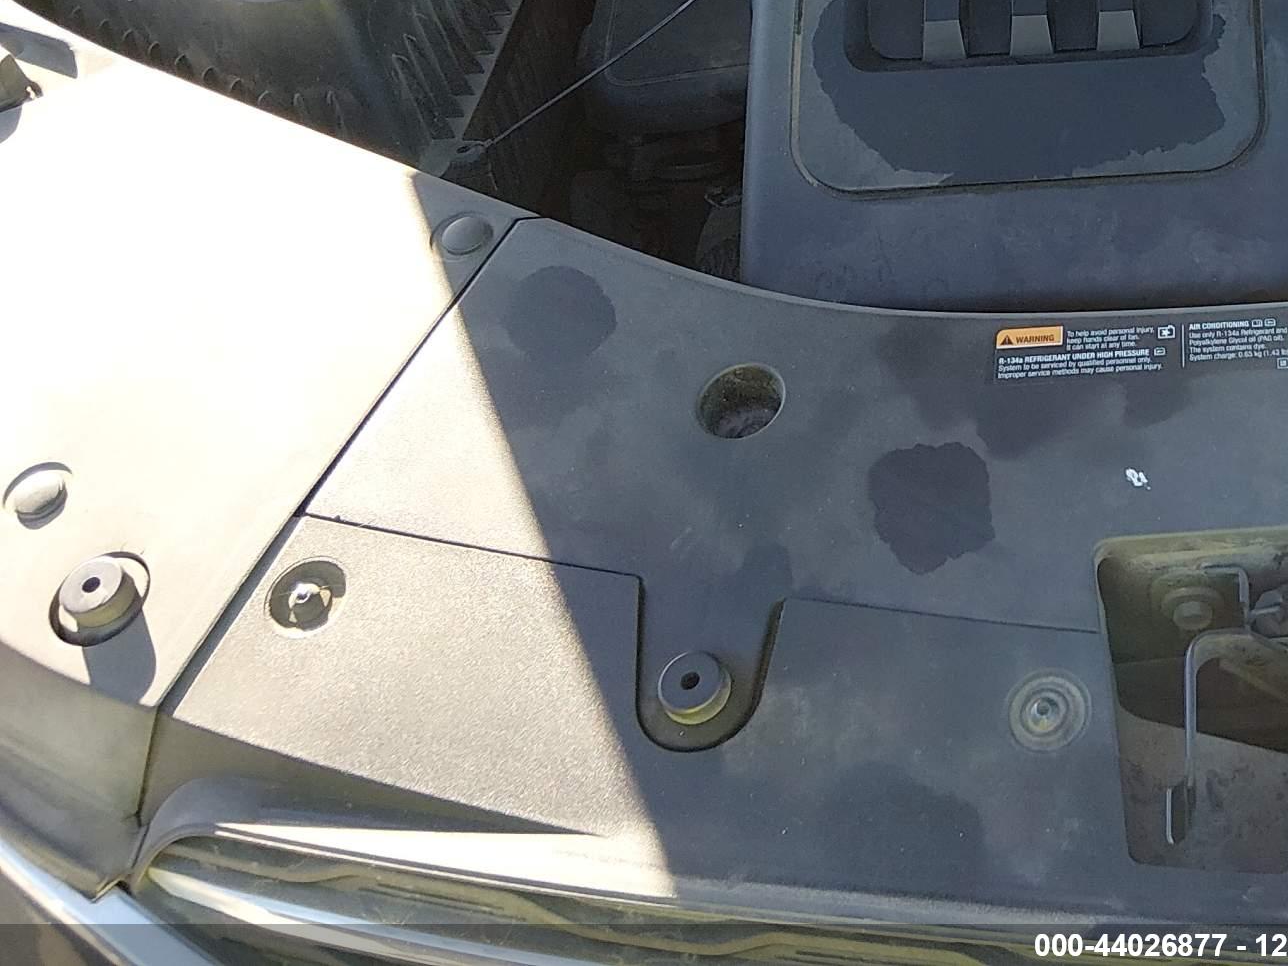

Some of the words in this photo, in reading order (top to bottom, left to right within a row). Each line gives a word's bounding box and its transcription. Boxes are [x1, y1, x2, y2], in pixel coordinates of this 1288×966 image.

[1202, 320, 1250, 330] CONDITIONING
[1108, 327, 1135, 336] personal
[1202, 331, 1215, 339] only
[1241, 328, 1275, 336] Refrigerant
[1016, 335, 1054, 344] WARNING
[1189, 337, 1228, 346] Polyalkylene
[1228, 336, 1248, 344] Glycol
[1202, 345, 1225, 353] system
[1226, 343, 1253, 351] contains
[998, 357, 1024, 365] R-134a
[1024, 354, 1071, 363] REFRIGERANT
[1072, 352, 1095, 360] UNDER
[1097, 350, 1113, 359] HIGH
[1115, 348, 1150, 358] PRESSURE
[1189, 353, 1213, 362] System
[1254, 350, 1263, 358] kg
[998, 364, 1022, 373] System
[1041, 361, 1067, 369] serviced
[1078, 359, 1105, 368] qualified
[1105, 357, 1137, 366] personnel
[1137, 356, 1152, 364] only.
[998, 371, 1026, 379] Improper
[1052, 368, 1080, 376] methods
[1080, 367, 1095, 375] may
[1115, 364, 1143, 373] personal
